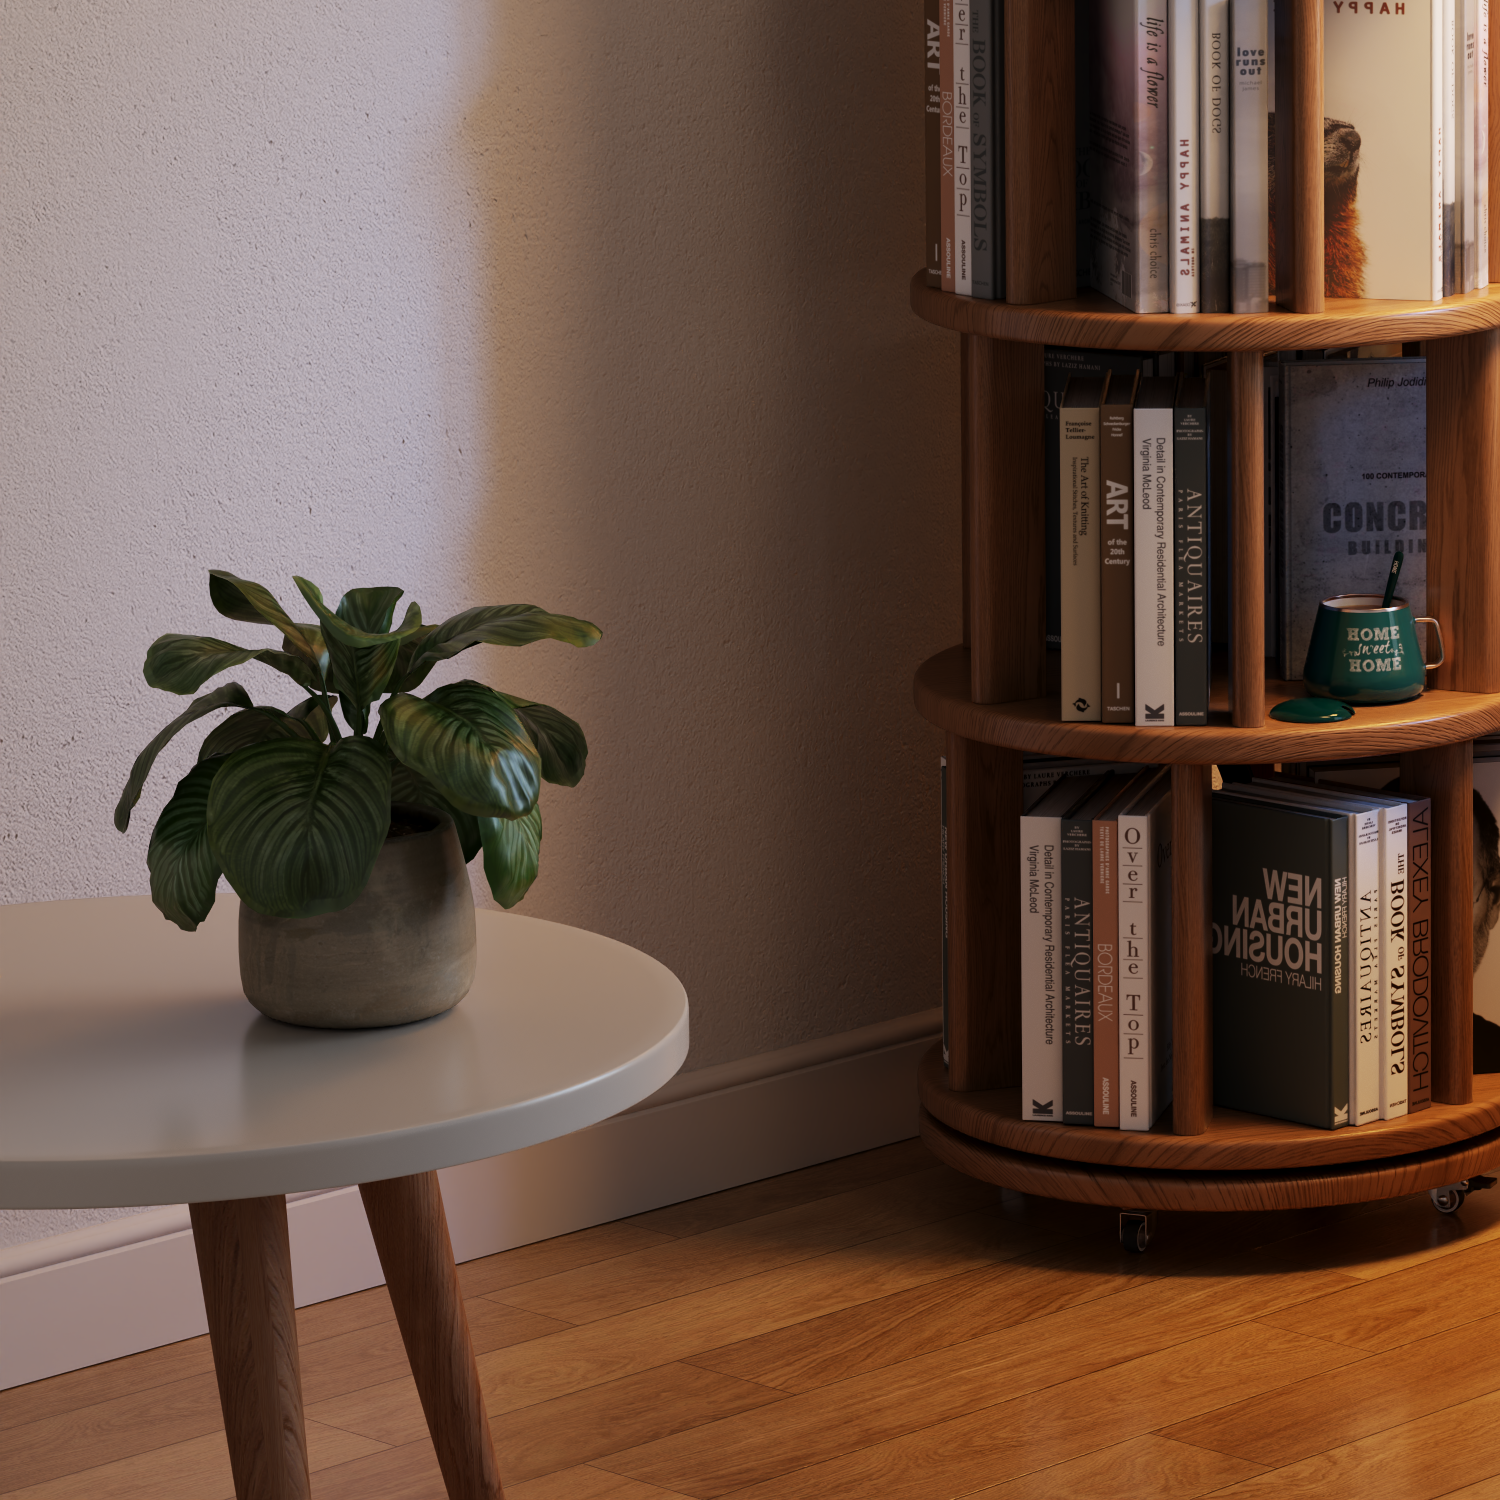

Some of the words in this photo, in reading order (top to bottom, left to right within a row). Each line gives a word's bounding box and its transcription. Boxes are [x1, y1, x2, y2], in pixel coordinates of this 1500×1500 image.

[1140, 17, 1164, 37] life
[926, 18, 940, 75] ART
[1146, 43, 1161, 52] is
[1147, 57, 1157, 66] a
[1236, 58, 1266, 67] runs
[1237, 47, 1264, 57] love
[972, 39, 986, 107] BOOK
[1240, 66, 1261, 75] out
[957, 67, 967, 124] the
[1140, 67, 1164, 108] flower
[942, 91, 953, 177] BORDEAUX
[958, 145, 968, 212] Top
[973, 133, 987, 252] SYMBOLS
[1150, 228, 1161, 249] chris
[1150, 252, 1162, 279] choice
[1057, 353, 1085, 362] VERCHERE
[1367, 377, 1395, 388] Philip
[1398, 376, 1427, 387] Jodidi
[1065, 420, 1092, 428] Françoise
[1080, 456, 1089, 473] The
[1140, 438, 1152, 471] Virginia
[1156, 437, 1166, 464] Detail
[1081, 474, 1089, 488] Art
[1156, 465, 1166, 474] in
[1376, 471, 1427, 480] CONTEMPOR
[1081, 488, 1089, 499] of
[1106, 479, 1129, 530] ART
[1142, 474, 1152, 510] McLeod
[1154, 476, 1166, 540] Contemporary
[1078, 501, 1089, 536] Knitting
[1323, 500, 1427, 534] CONCR
[1107, 538, 1116, 546] of
[1116, 538, 1127, 546] the
[1348, 538, 1427, 555] BUILDIN
[1104, 557, 1130, 566] Century
[1156, 541, 1166, 591] Residential
[1183, 488, 1203, 643] ANTIQUAIRES
[1156, 593, 1166, 647] Architecture
[1346, 626, 1400, 641] HOME
[1348, 657, 1402, 672] HOME
[1027, 845, 1039, 877] Virginia
[1044, 845, 1054, 870] Detail
[1124, 827, 1141, 899] Over
[1044, 871, 1054, 879] in
[1029, 879, 1039, 914] McLeod
[1043, 881, 1054, 942] Contemporary
[1126, 922, 1139, 975] the
[1045, 944, 1055, 992] Residential
[1071, 897, 1091, 1046] ANTIQUAIRES
[1097, 943, 1113, 1022] BORDEAUX
[1045, 993, 1055, 1045] Architecture
[1126, 994, 1140, 1055] Top
